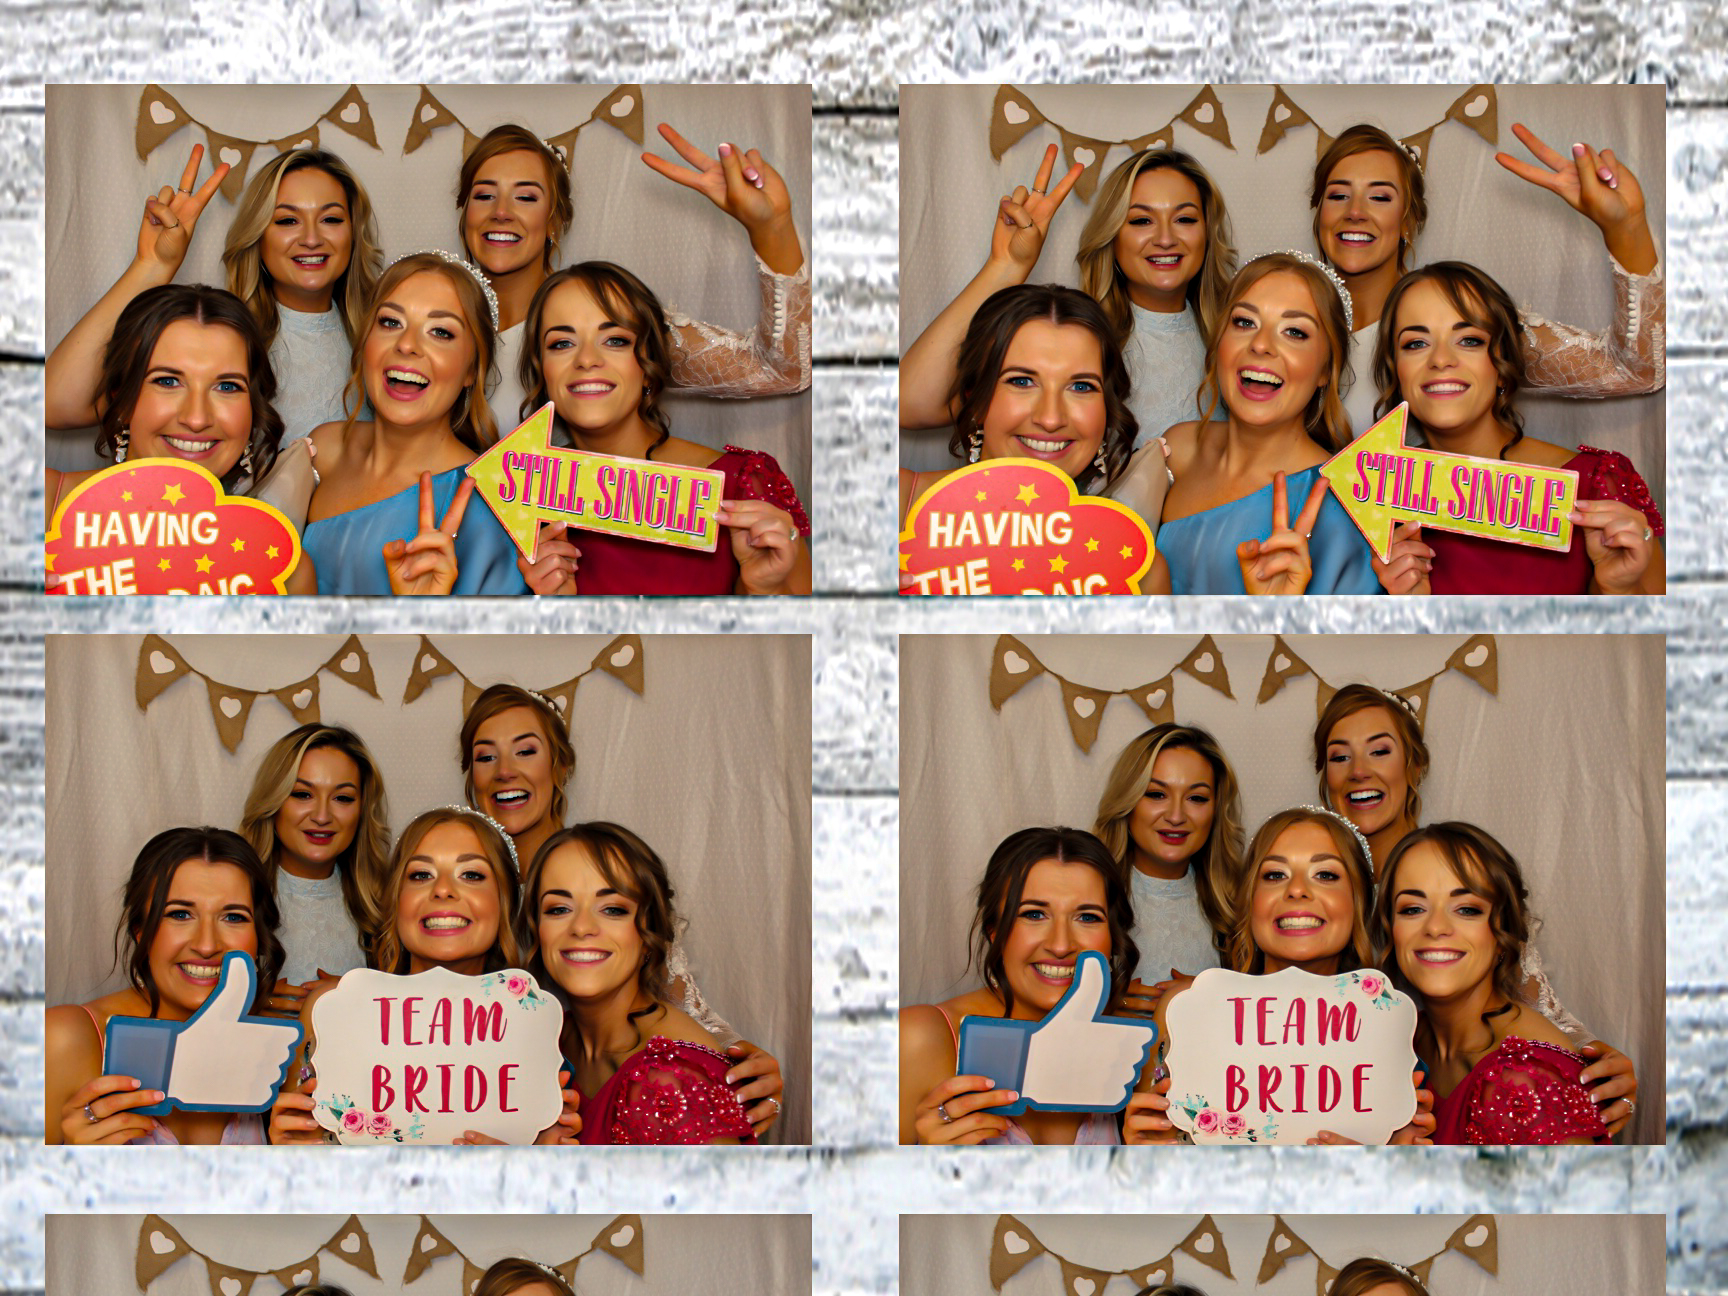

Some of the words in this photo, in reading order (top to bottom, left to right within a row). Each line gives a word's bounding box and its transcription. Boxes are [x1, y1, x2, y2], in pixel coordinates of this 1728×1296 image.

[499, 450, 584, 515] STILL
[593, 465, 712, 536] SINGLE
[1353, 450, 1438, 515] STILL
[1447, 465, 1566, 536] SINGLE
[74, 511, 219, 548] HAVING
[928, 511, 1073, 548] HAVING
[59, 557, 138, 595] THE
[913, 557, 992, 595] THE
[372, 996, 508, 1046] TEAM
[1226, 996, 1362, 1046] TEAM
[371, 1063, 520, 1113] BRIDE
[1225, 1063, 1374, 1113] BRIDE
